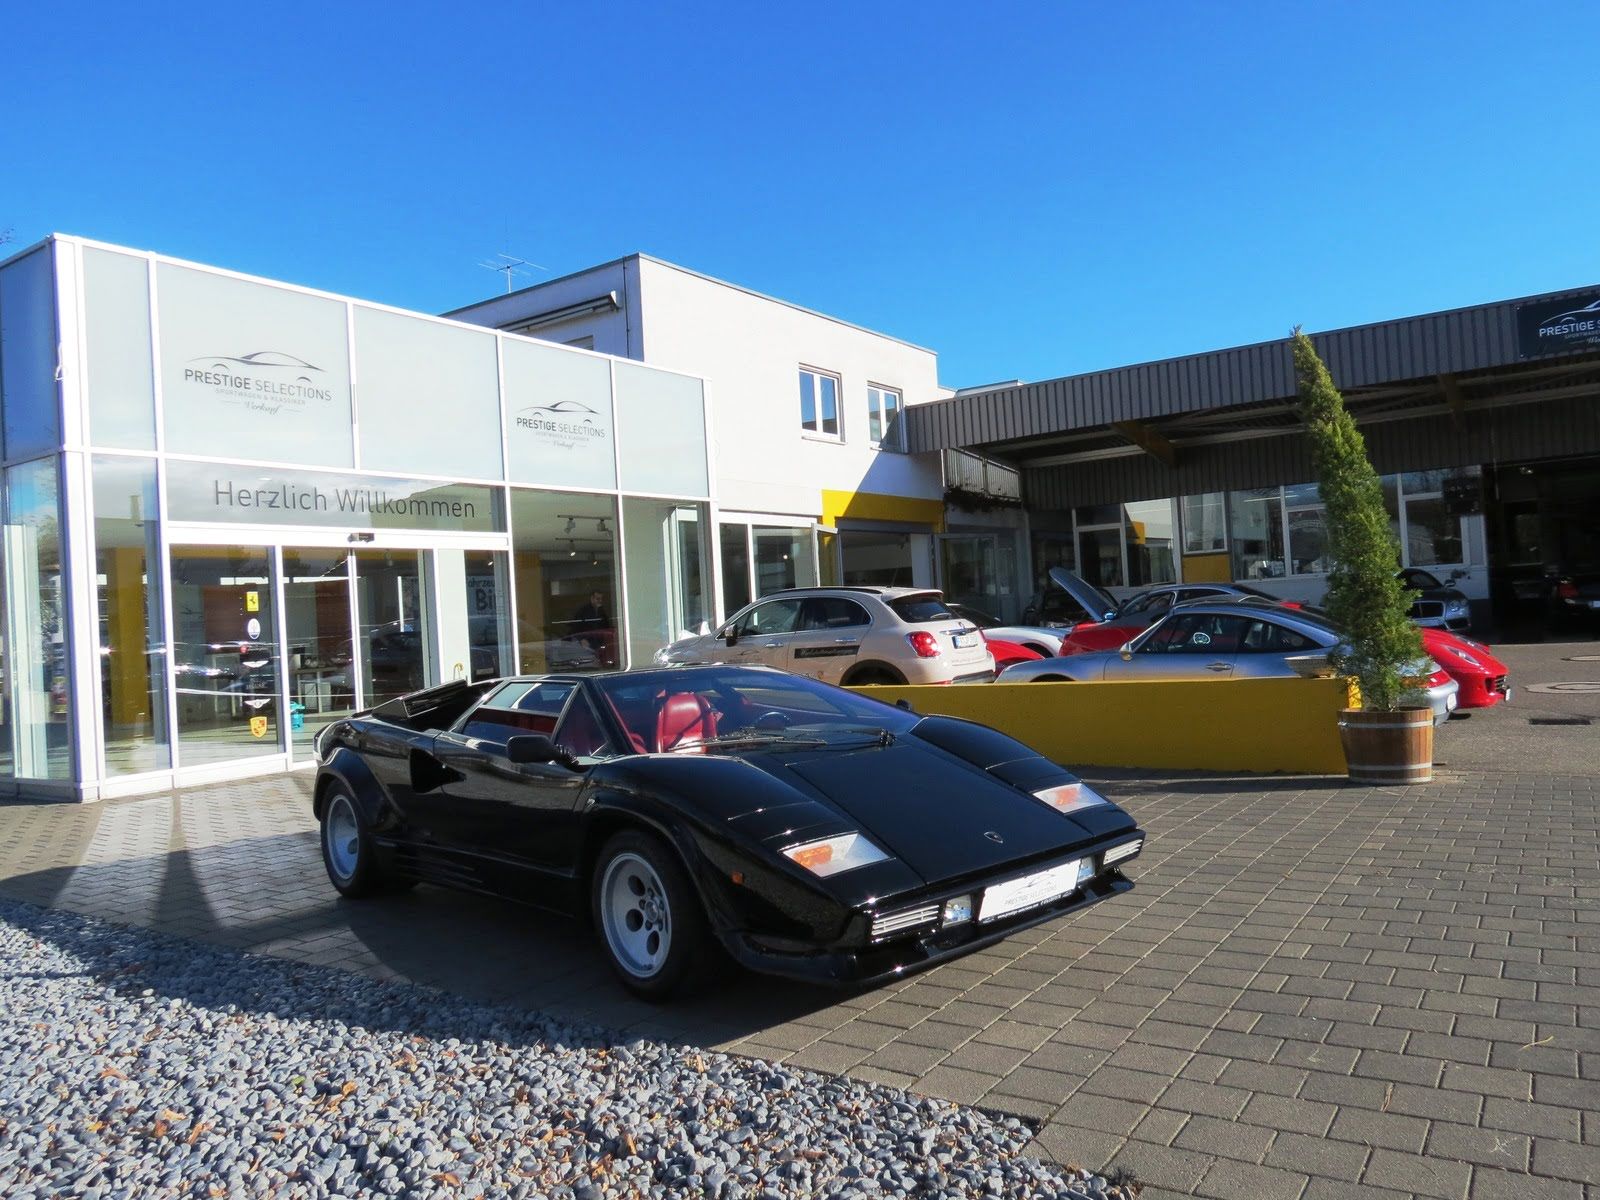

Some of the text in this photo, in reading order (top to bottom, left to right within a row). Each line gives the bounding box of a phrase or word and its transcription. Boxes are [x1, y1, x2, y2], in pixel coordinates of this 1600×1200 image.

[1539, 320, 1595, 337] PRESTIGE
[184, 368, 332, 401] PRESTIGE SELECTIONS
[516, 417, 557, 432] PRESTIGE
[558, 422, 605, 438] SELECTIONS
[214, 480, 475, 518] Herzlich Willkommen
